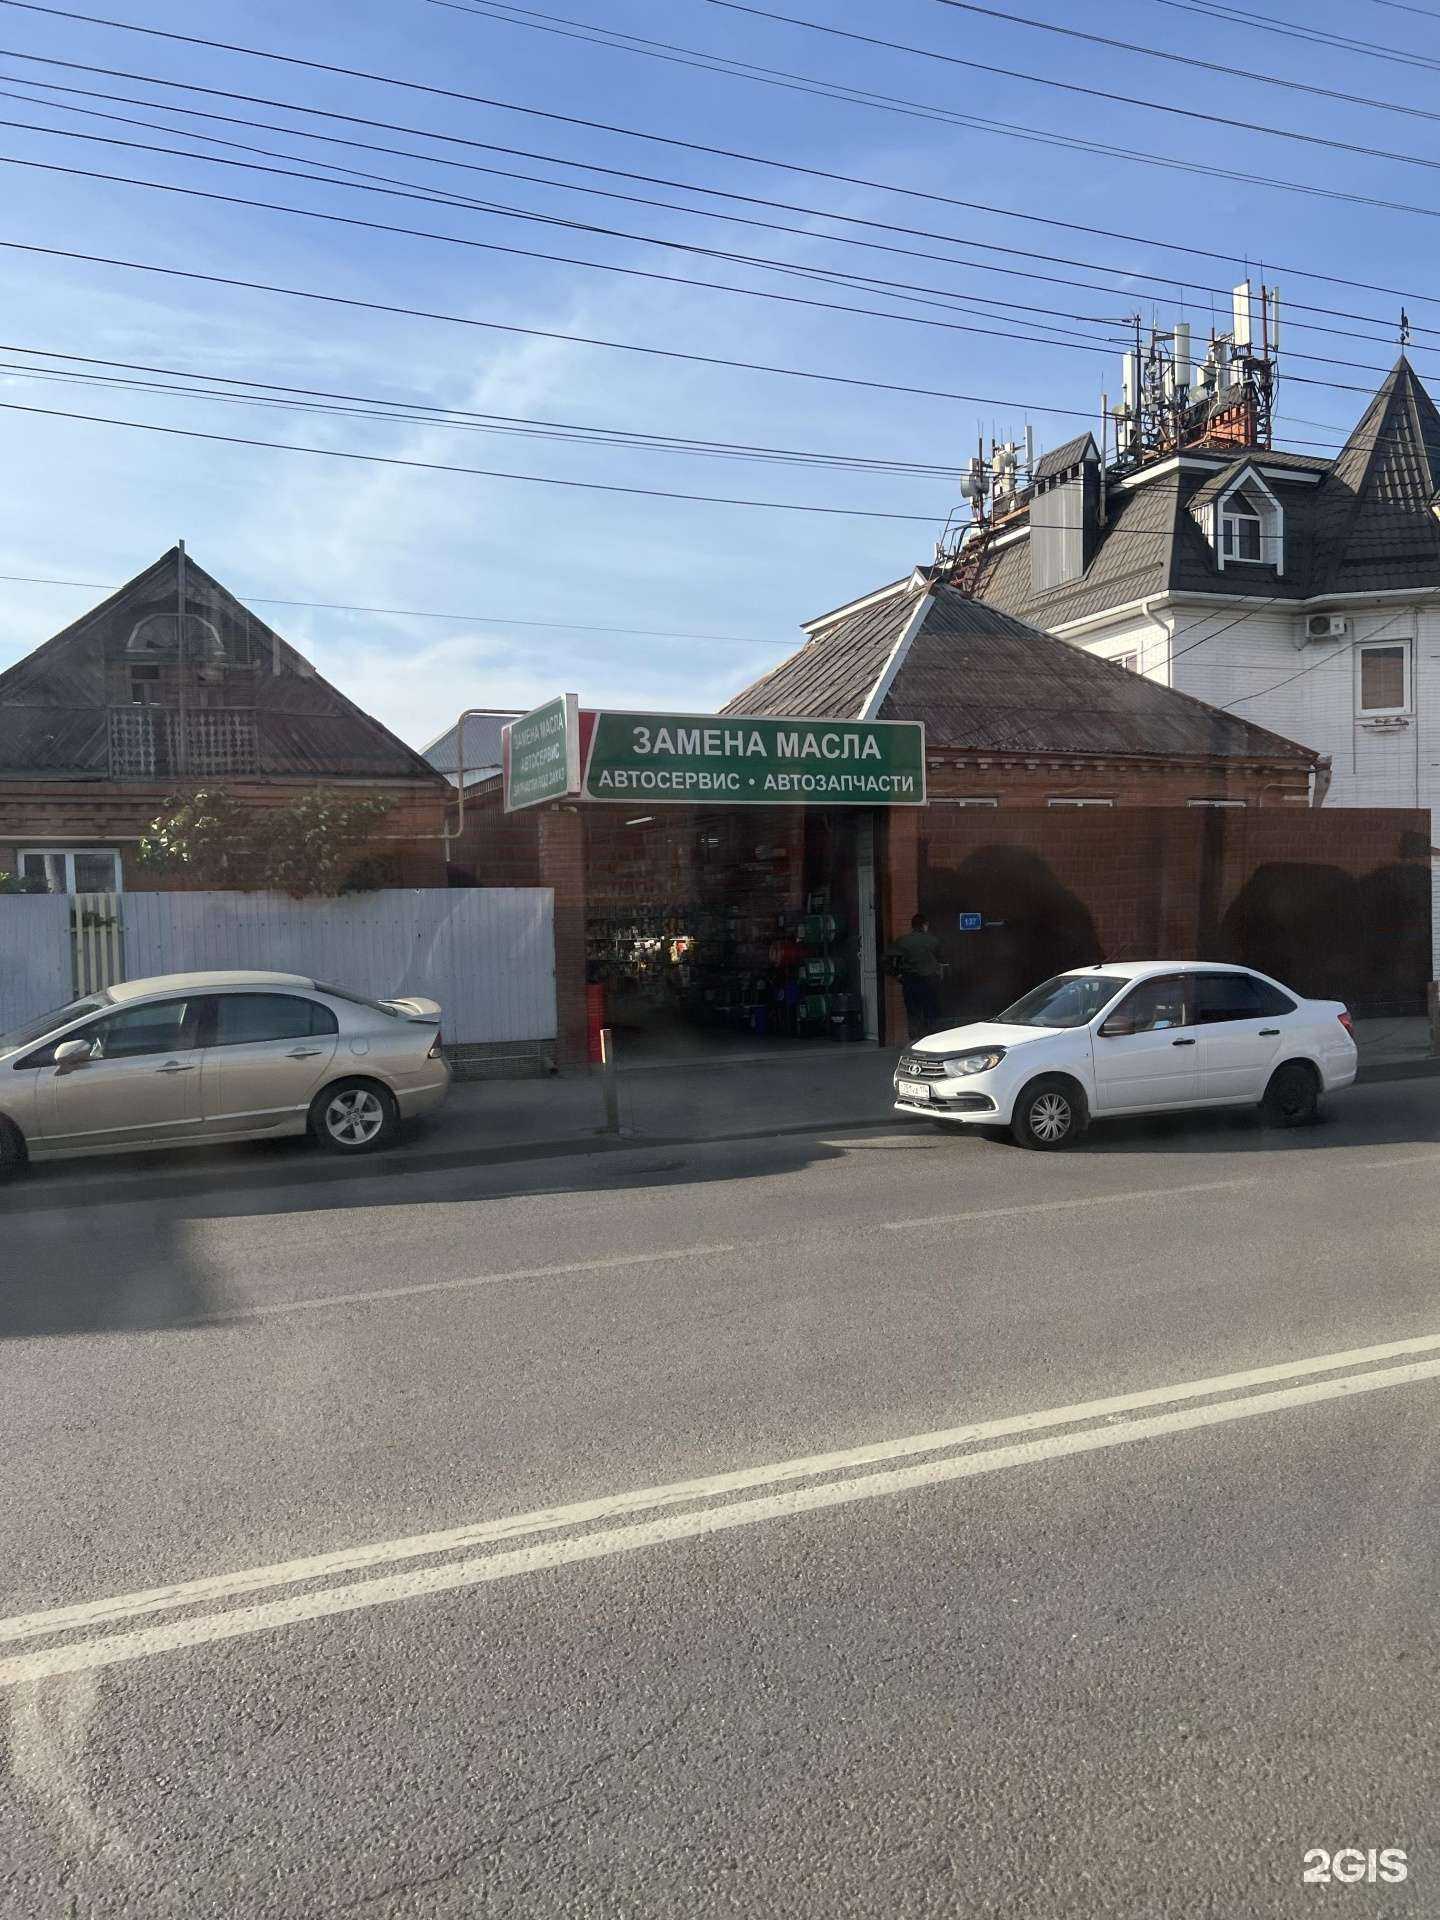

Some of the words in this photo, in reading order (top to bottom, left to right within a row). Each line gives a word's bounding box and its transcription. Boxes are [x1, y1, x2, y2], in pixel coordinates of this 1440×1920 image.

[541, 713, 564, 737] МАСЛА
[632, 726, 767, 757] ЗАМЕНА
[776, 732, 882, 759] МАСЛА
[598, 769, 740, 790] АВТОСЕРВИС
[763, 773, 914, 792] АВТОЗАПЧАСТИ
